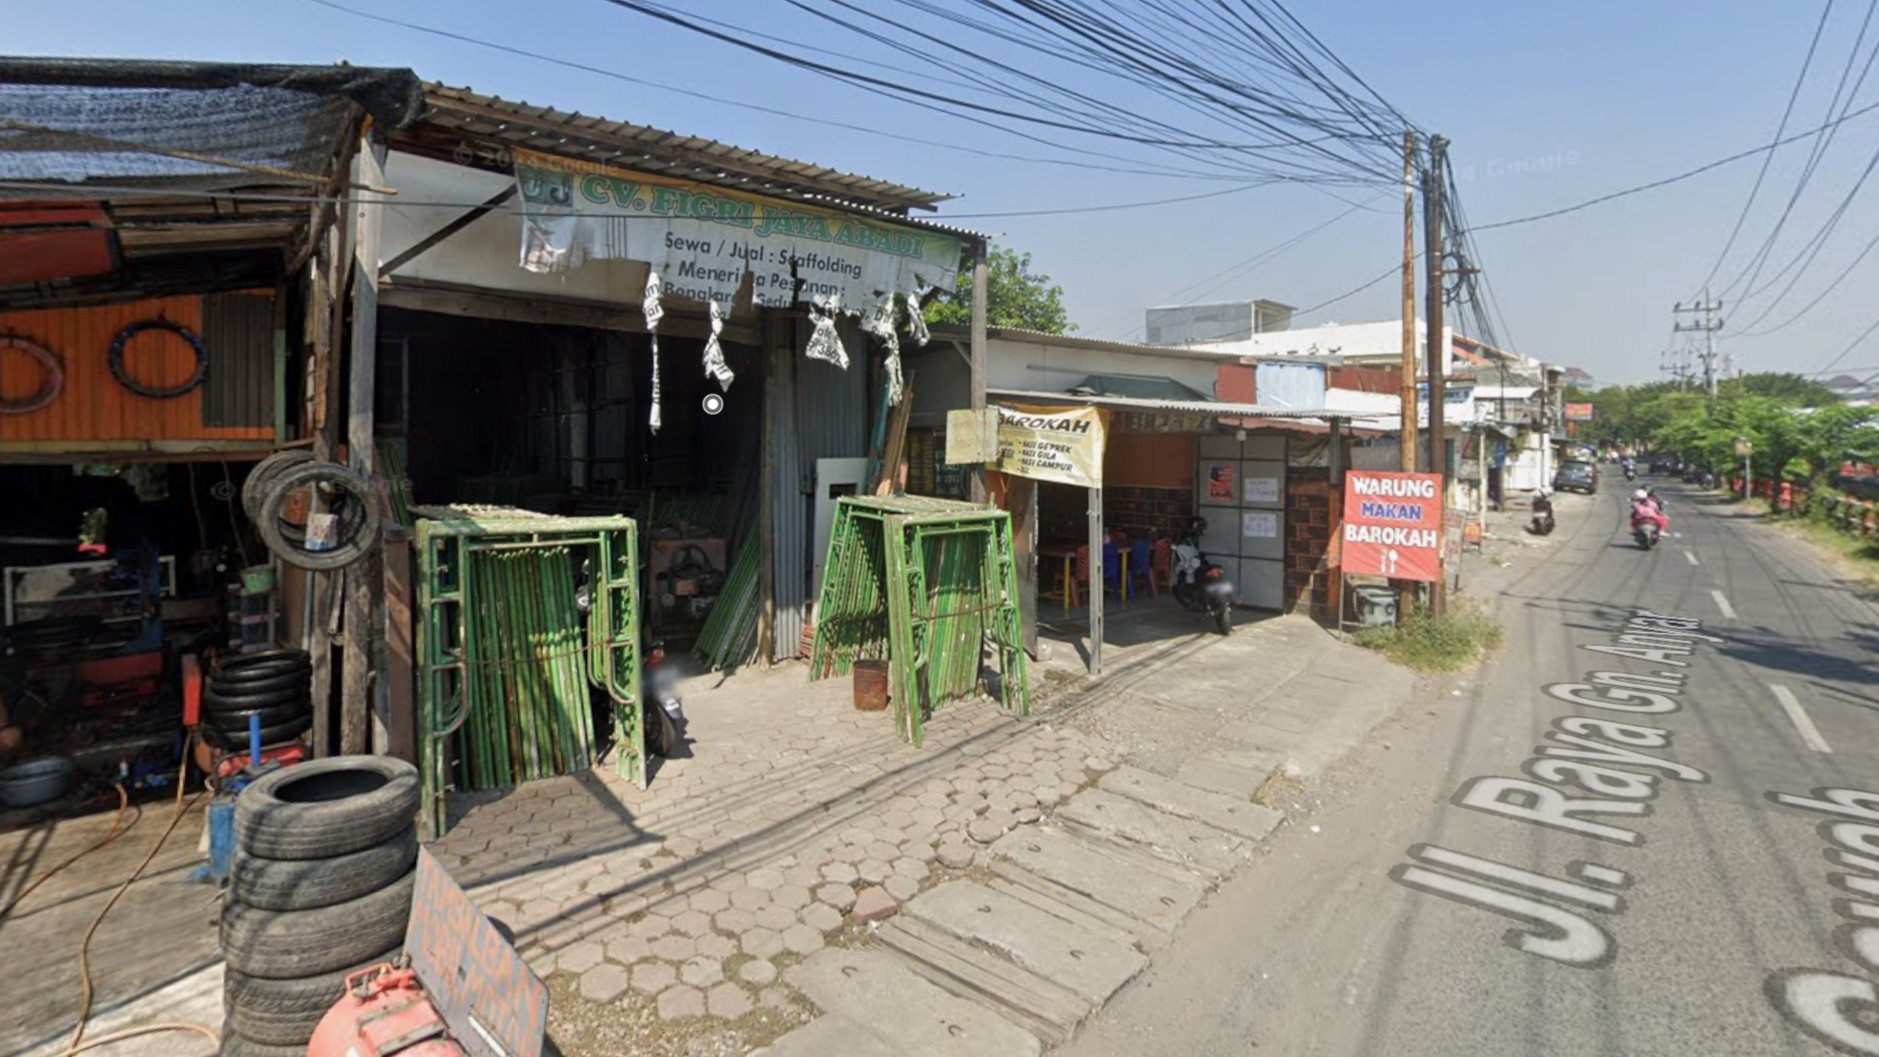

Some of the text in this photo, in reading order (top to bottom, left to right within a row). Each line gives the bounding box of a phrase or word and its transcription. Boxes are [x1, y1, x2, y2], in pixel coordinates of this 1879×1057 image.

[580, 174, 646, 212] CV.
[754, 206, 832, 242] JAYA
[834, 220, 925, 259] ABADI
[665, 231, 711, 254] Sewa
[716, 240, 726, 257] /
[729, 242, 764, 262] Jual
[678, 260, 766, 287] Meneria
[1036, 460, 1073, 472] CAMPUR
[1037, 451, 1057, 460] GILA
[1352, 476, 1435, 499] WARUNG
[1361, 502, 1422, 520] MAKAN
[1344, 523, 1437, 549] BAROKAH
